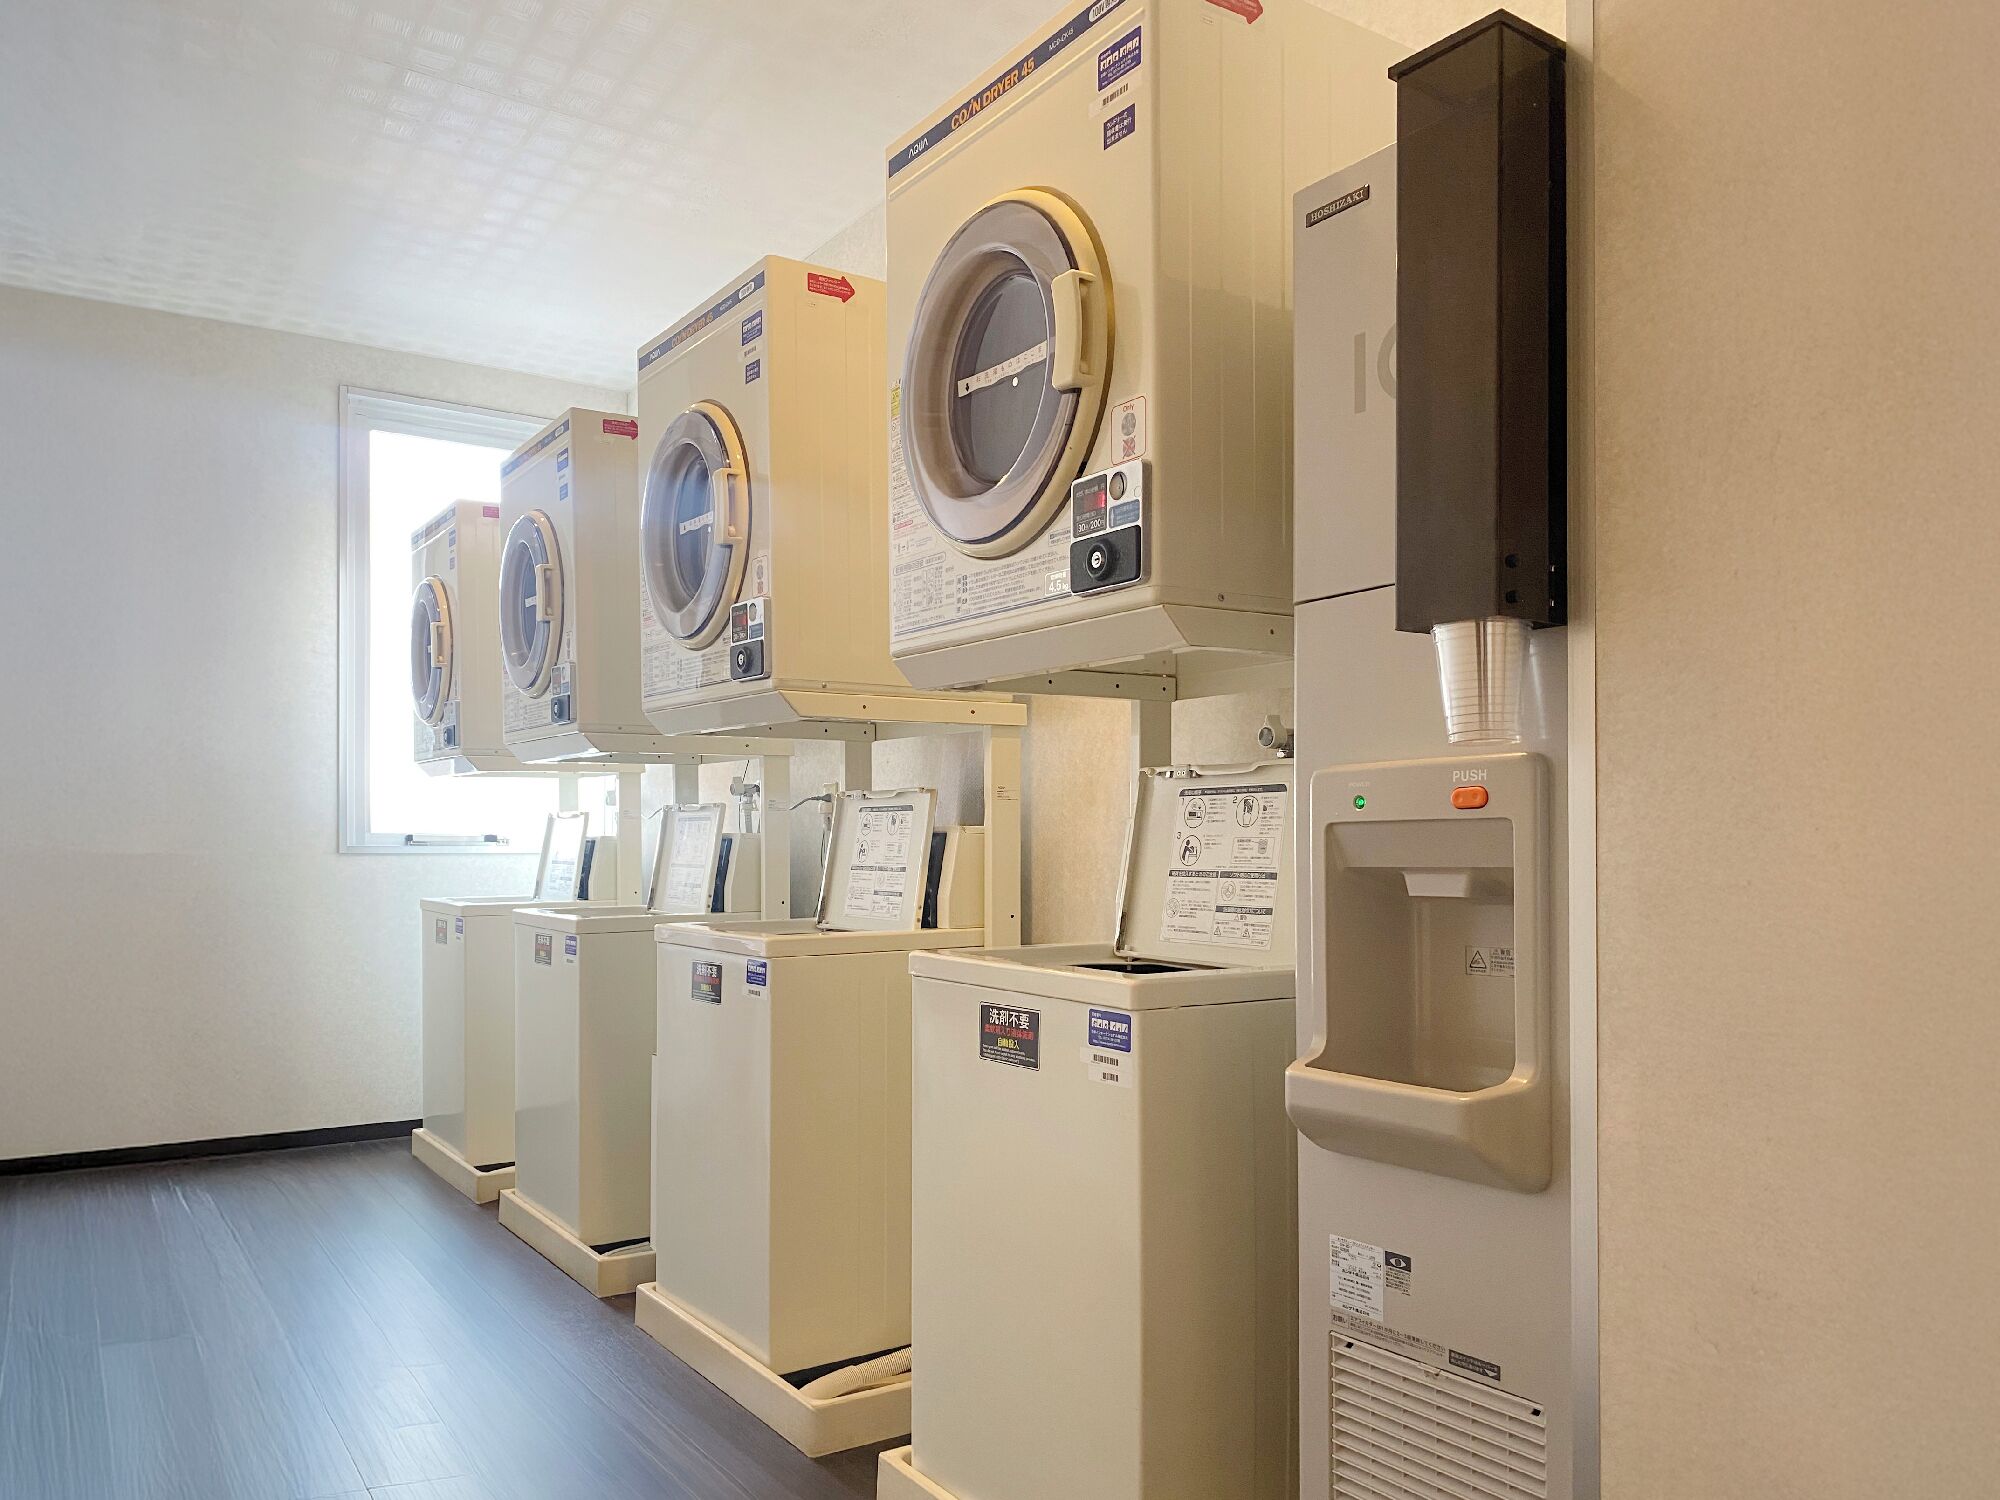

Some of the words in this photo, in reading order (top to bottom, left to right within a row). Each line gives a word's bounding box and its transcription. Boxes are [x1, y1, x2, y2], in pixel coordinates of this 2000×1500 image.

[983, 69, 1019, 107] DRYER
[1021, 56, 1035, 77] 45
[908, 138, 928, 158] AQUA
[1311, 189, 1364, 222] HOSHIZAKI
[1048, 580, 1061, 592] 4.5
[1453, 769, 1487, 782] PUSH
[1232, 796, 1238, 804] 2
[1176, 832, 1182, 840] 3
[989, 1007, 1030, 1030] 洗剤不要
